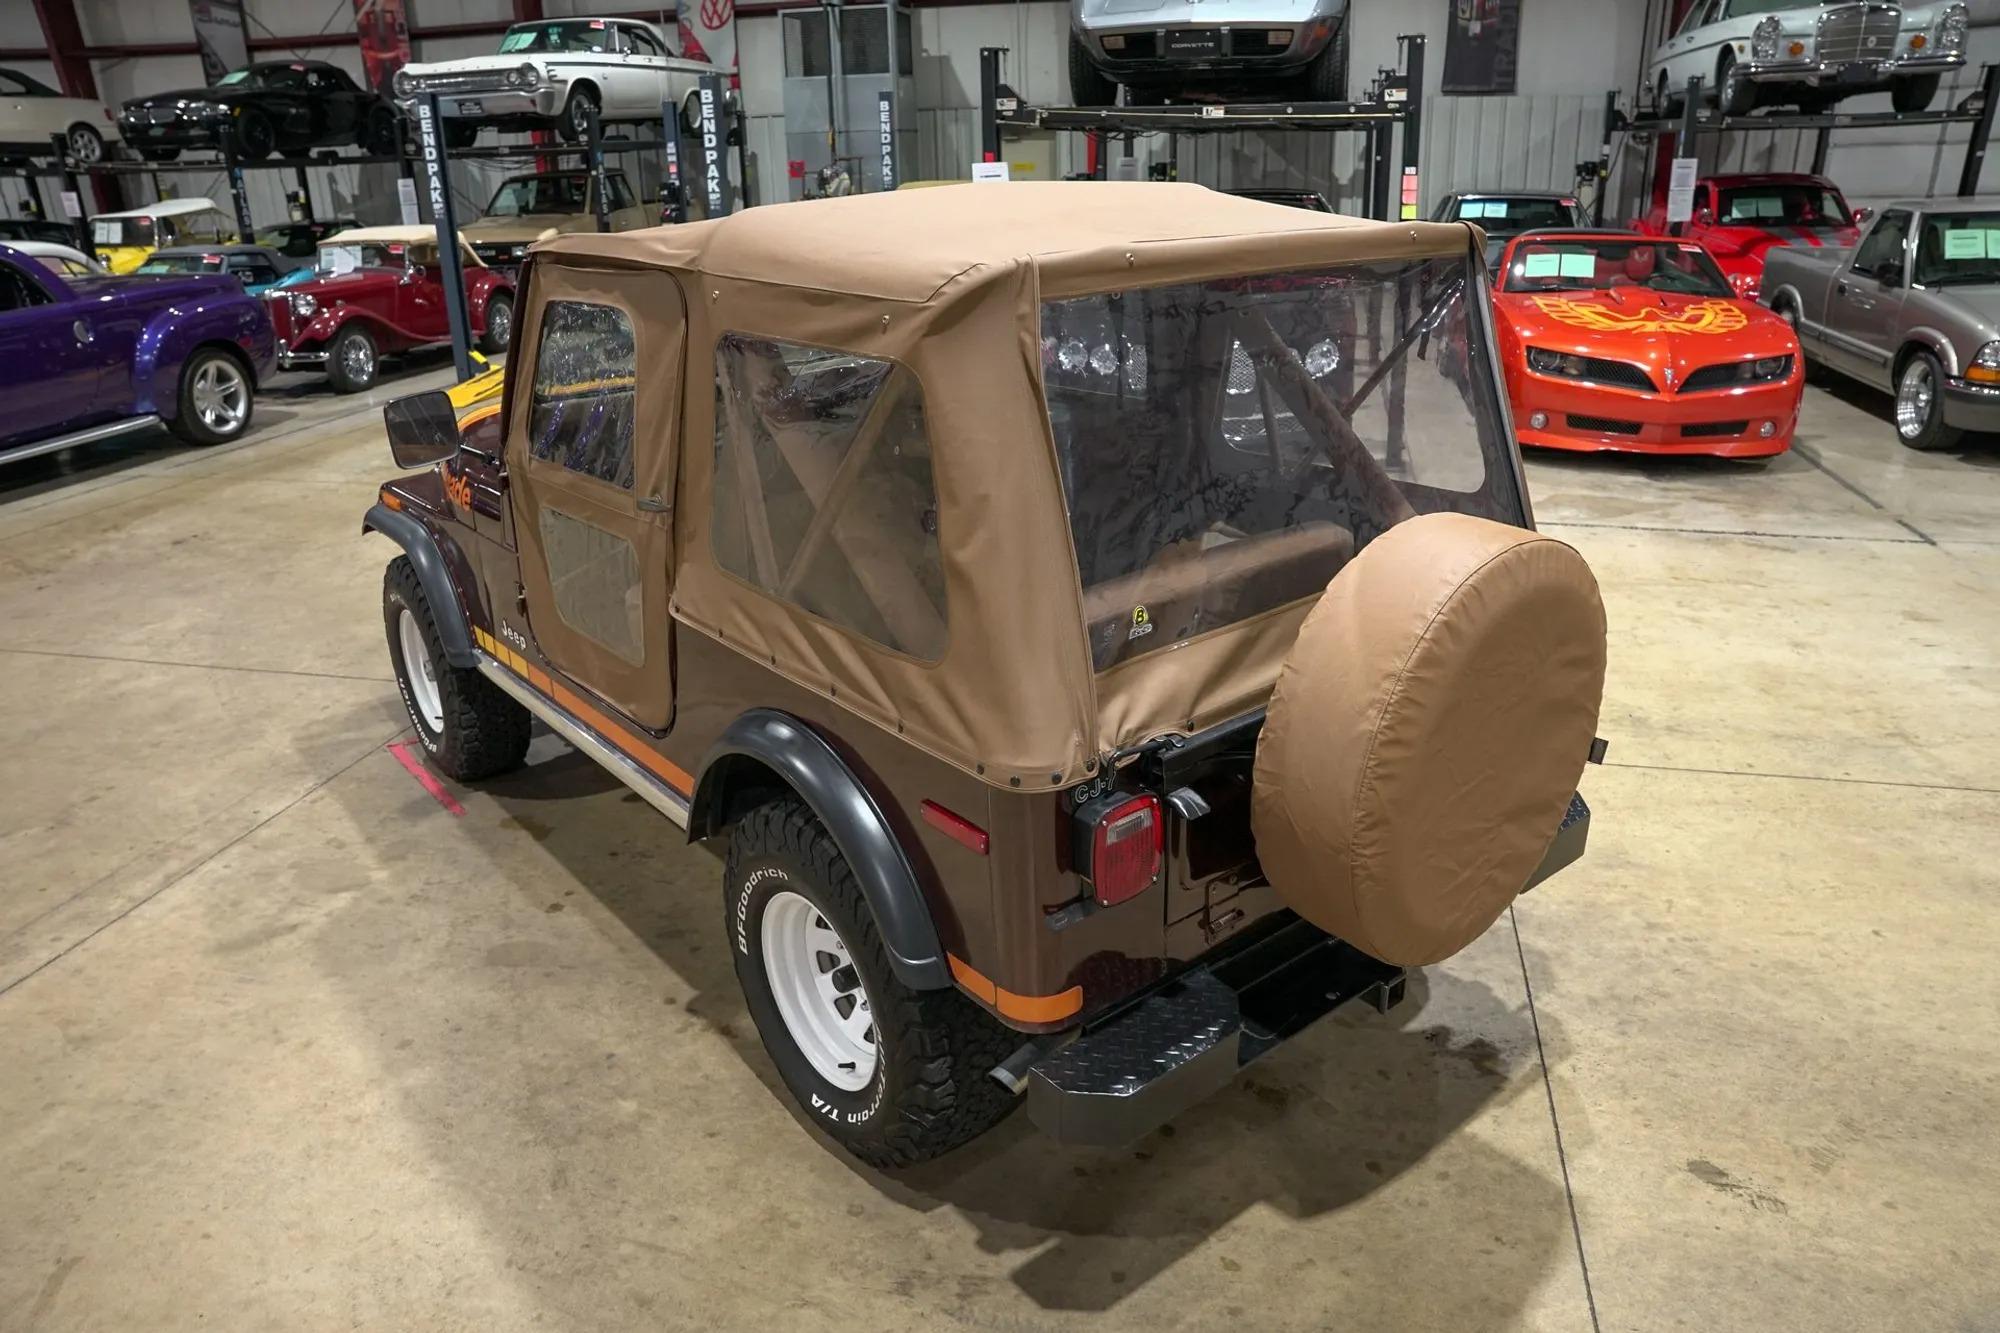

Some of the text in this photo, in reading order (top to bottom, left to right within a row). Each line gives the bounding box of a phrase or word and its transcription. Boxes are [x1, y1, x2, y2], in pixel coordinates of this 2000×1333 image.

[418, 105, 443, 202] BENDPAK
[701, 89, 721, 192] BENDPAK
[879, 101, 893, 176] BENDPAK
[502, 619, 527, 650] Jeep
[737, 867, 788, 955] BFGoodrich
[811, 1092, 840, 1122] T/A
